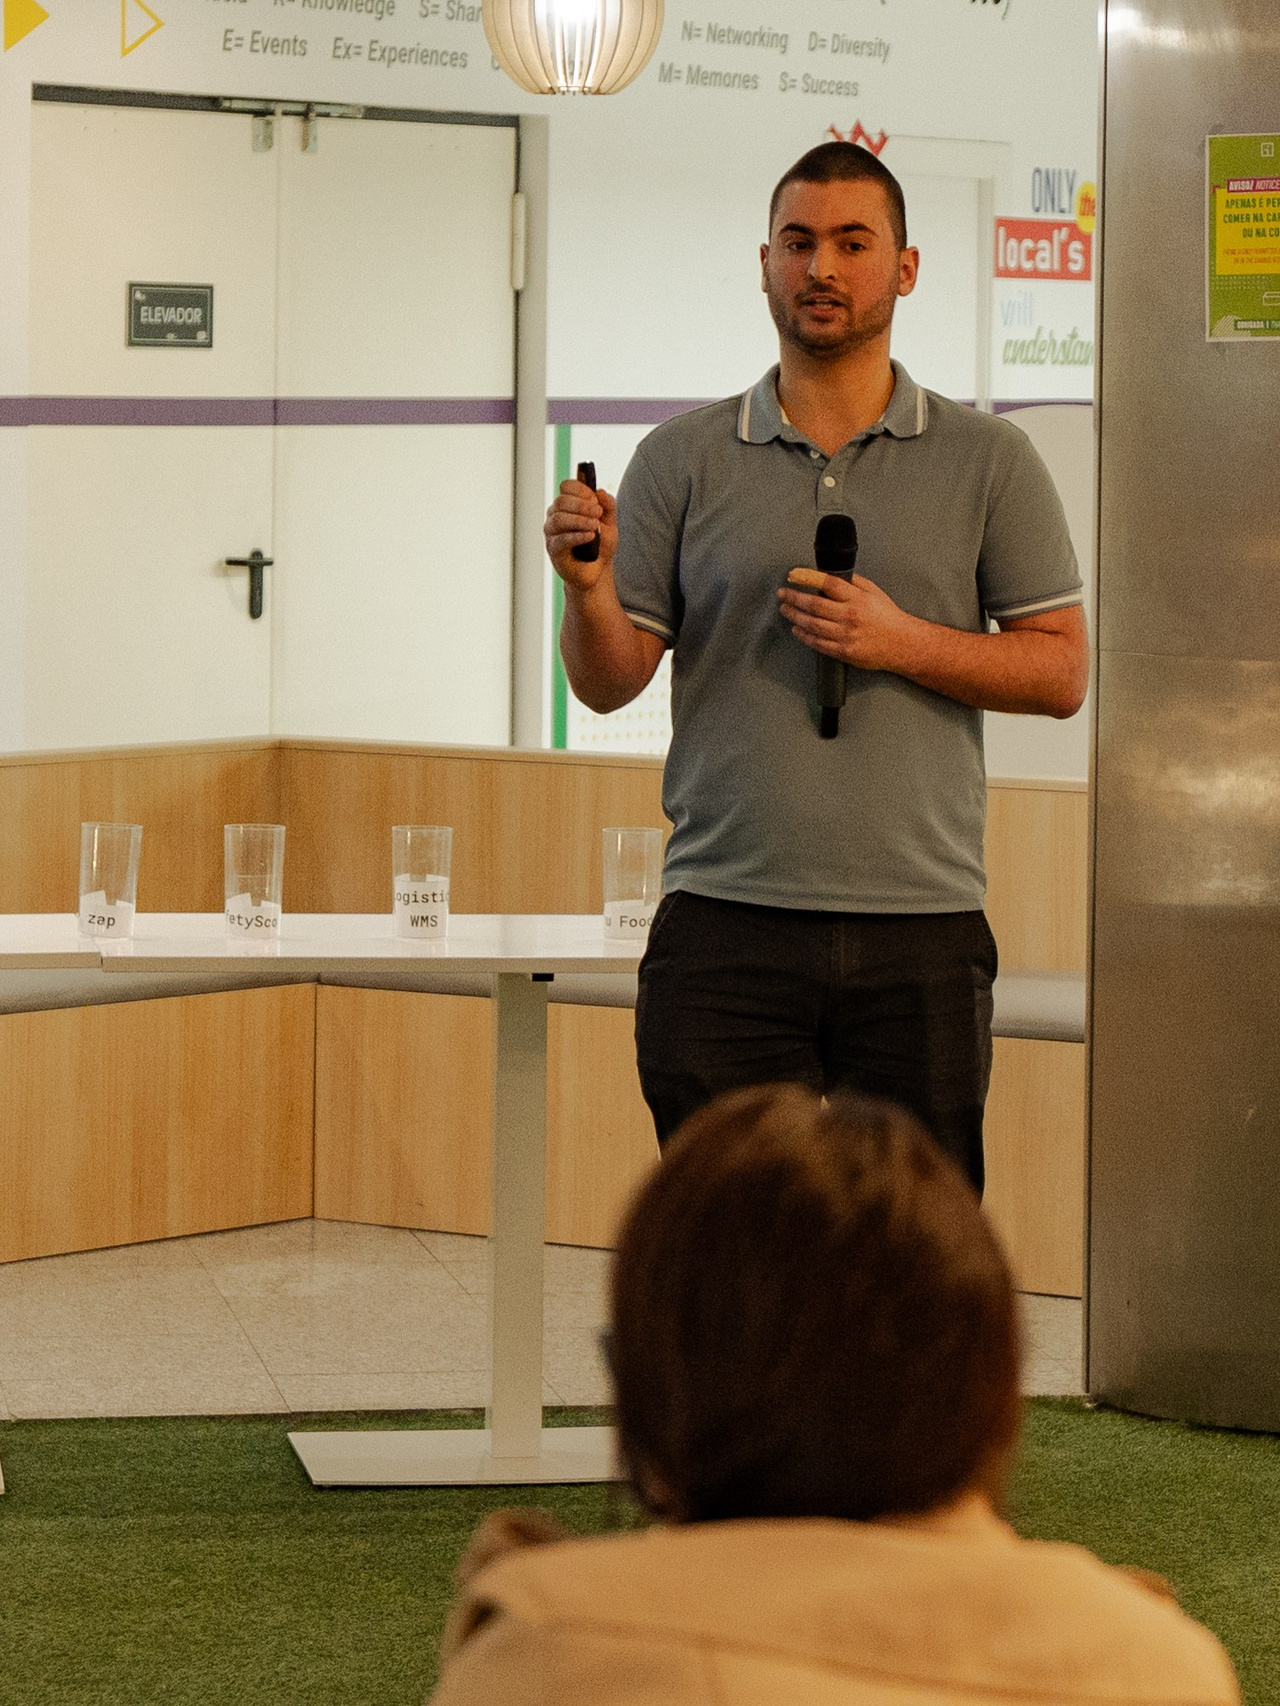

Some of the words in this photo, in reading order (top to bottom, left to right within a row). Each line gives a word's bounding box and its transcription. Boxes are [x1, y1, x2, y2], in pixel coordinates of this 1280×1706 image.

[681, 20, 703, 42] N=
[705, 22, 789, 54] Networking
[808, 31, 827, 52] D=
[830, 33, 891, 64] Diversity
[222, 28, 244, 52] E=
[249, 30, 308, 57] Events
[332, 37, 363, 60] Ex=
[367, 39, 468, 68] Experiences
[658, 62, 682, 84] M=
[685, 64, 760, 90] Memories
[778, 71, 797, 92] S=
[801, 73, 860, 97] Success
[1031, 166, 1077, 215] ONLY
[1224, 198, 1257, 209] APENAS
[1222, 213, 1251, 224] COMER
[1252, 213, 1264, 223] NA
[1242, 228, 1254, 238] OU
[1255, 227, 1267, 237] NA
[997, 226, 1086, 273] local's
[140, 305, 203, 325] ELEVADOR
[1000, 290, 1034, 327] will
[88, 913, 116, 930] zap
[410, 914, 438, 928] WMS
